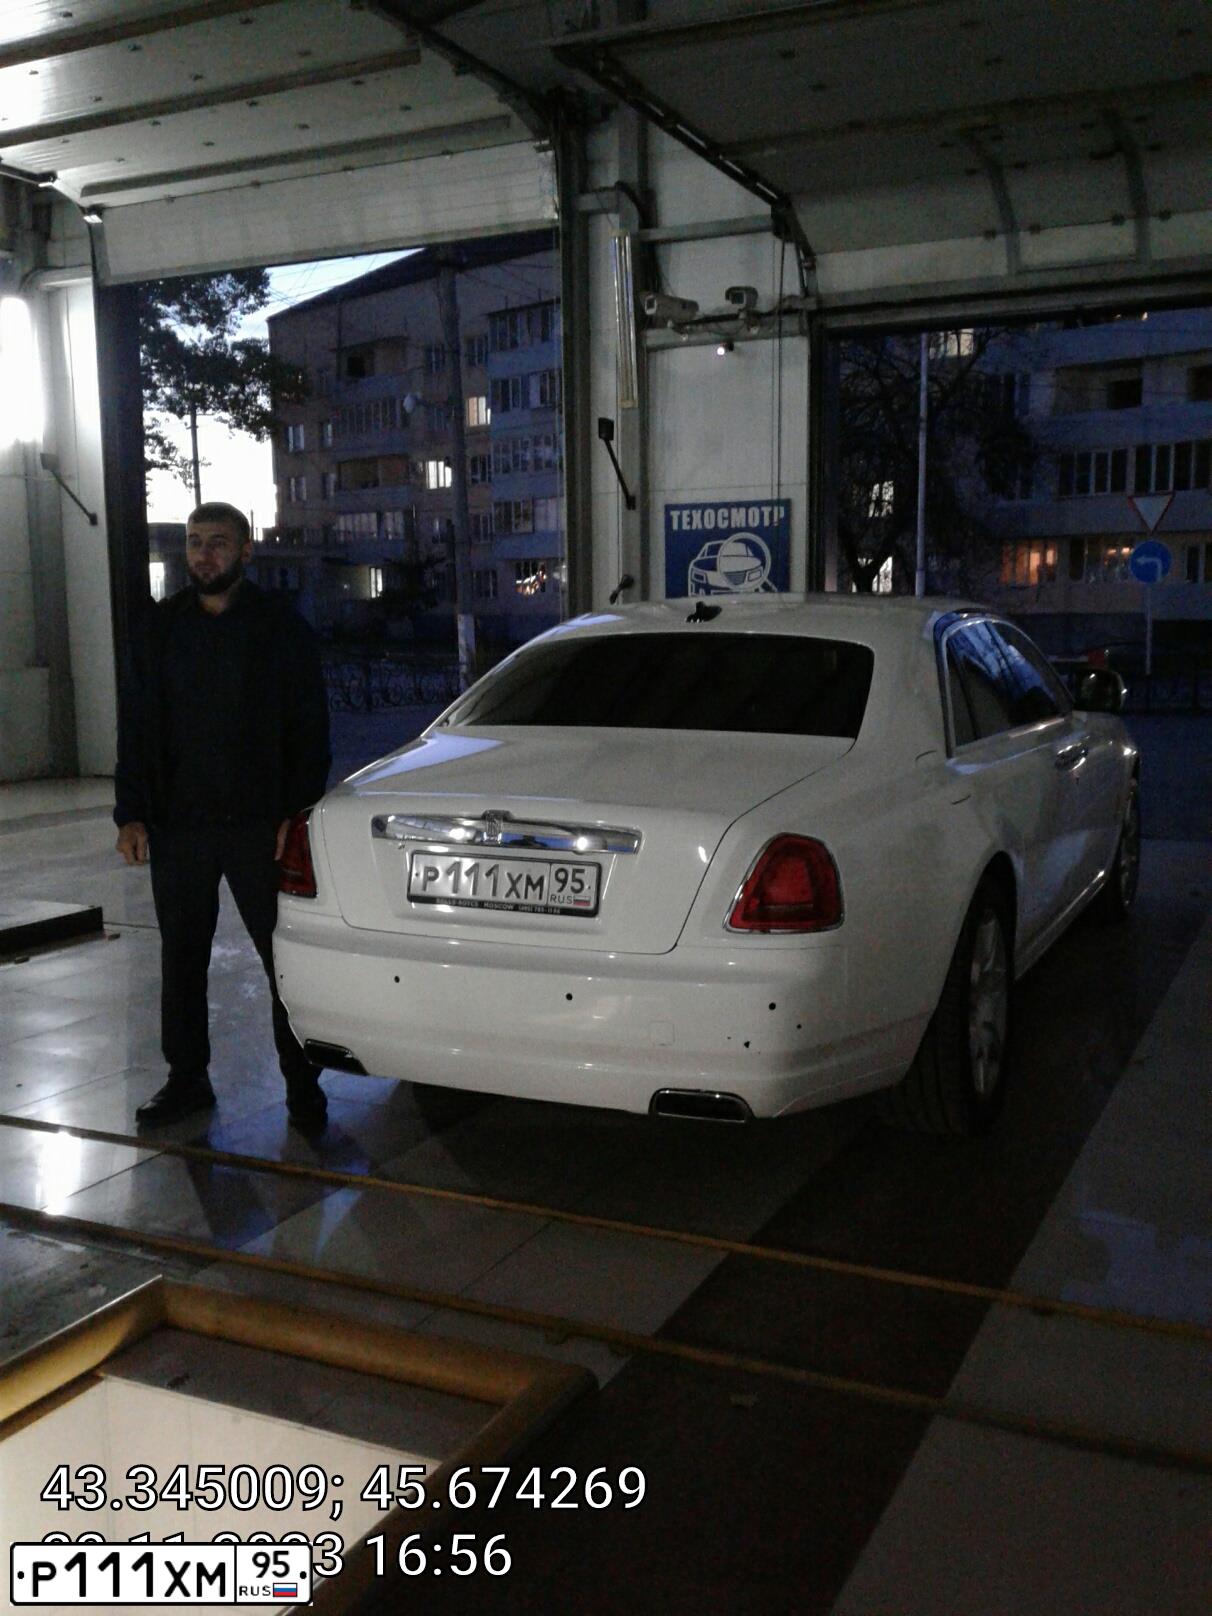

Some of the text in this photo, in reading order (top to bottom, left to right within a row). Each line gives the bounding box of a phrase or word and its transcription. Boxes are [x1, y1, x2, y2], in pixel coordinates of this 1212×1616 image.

[670, 506, 785, 531] ТЕХОСМОТР
[422, 861, 585, 900] Р111ХМ 95
[550, 894, 573, 905] RUS
